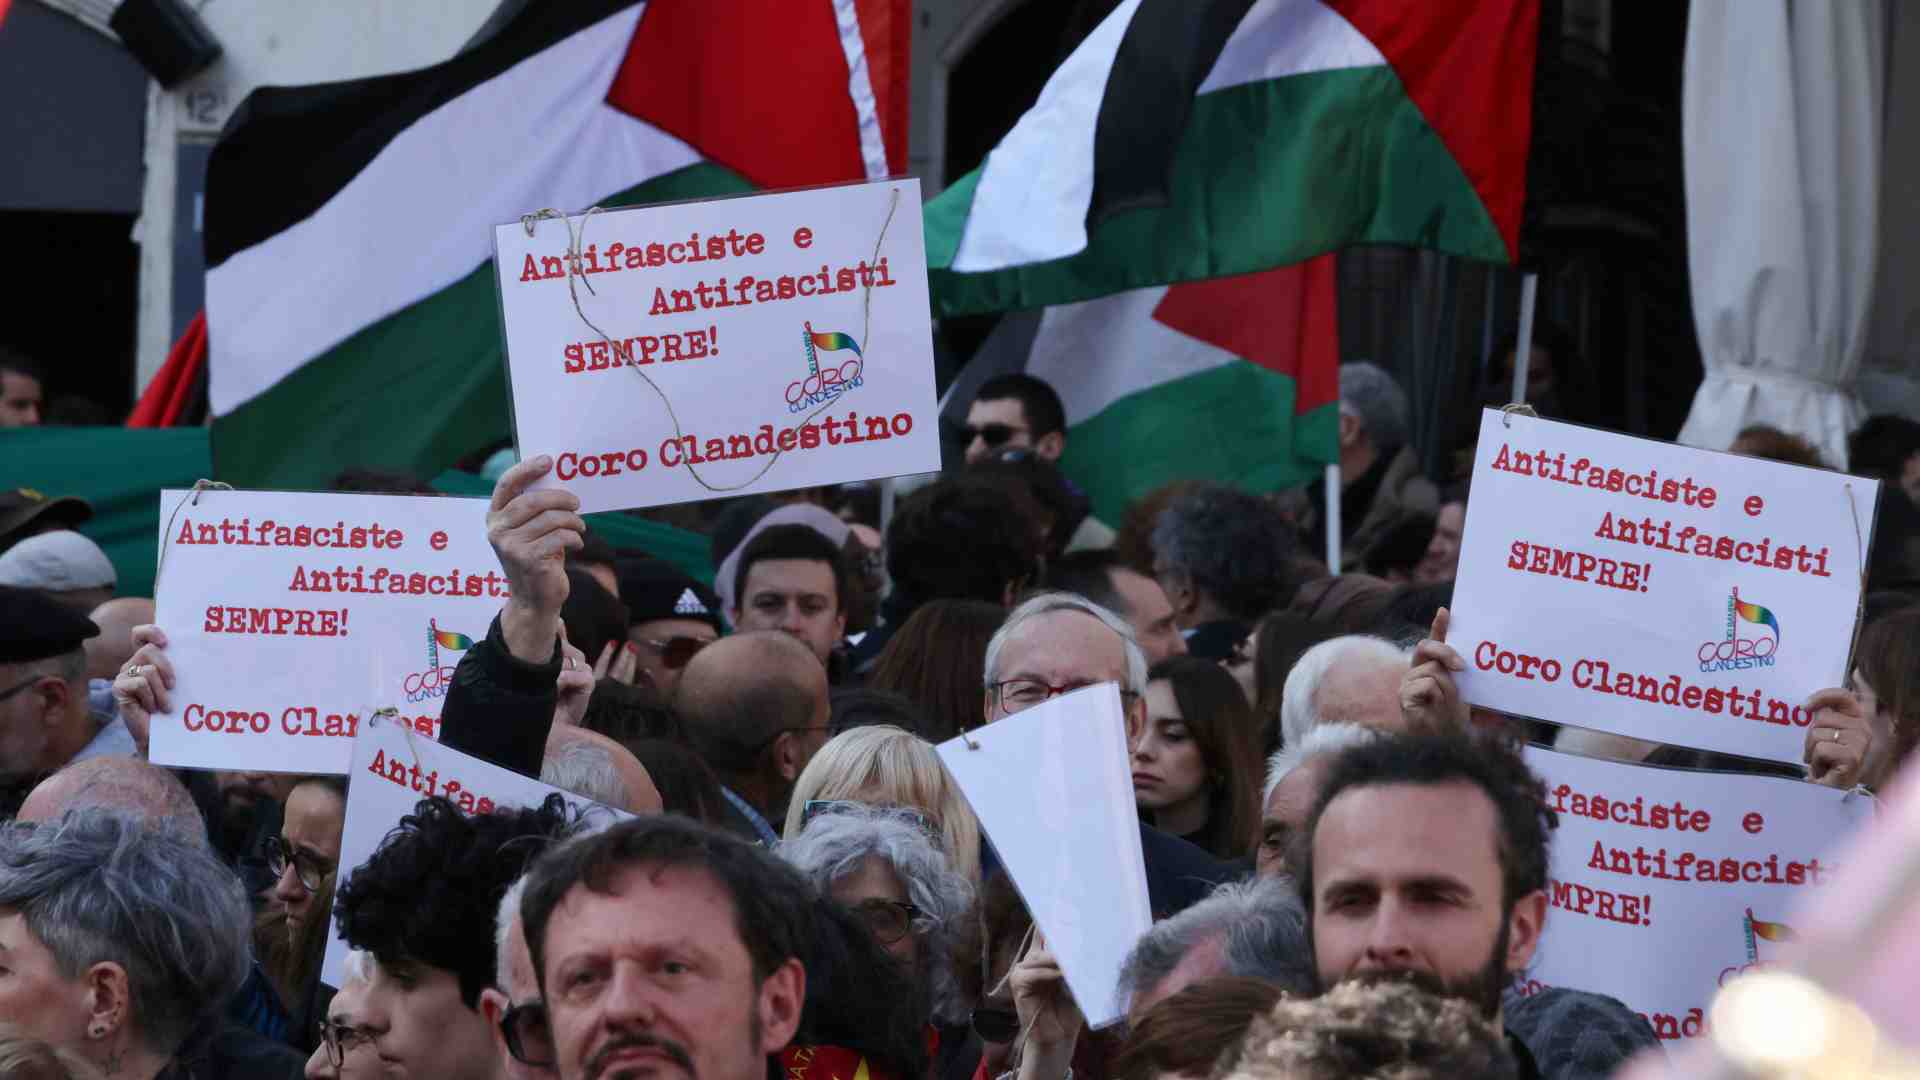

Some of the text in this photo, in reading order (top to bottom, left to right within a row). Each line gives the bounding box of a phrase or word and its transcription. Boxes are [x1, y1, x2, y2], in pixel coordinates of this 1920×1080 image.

[520, 227, 813, 283] Antifasciste e
[648, 258, 897, 317] Antifascisti
[564, 326, 719, 374] SEMPRE!
[555, 411, 913, 482] Coro Clandestino
[1492, 443, 1765, 517] Antifasciste e
[176, 518, 449, 551] Antifasciste e
[1594, 512, 1832, 578] Antifascisti
[1507, 540, 1652, 593] SEMPRE!
[203, 606, 349, 638] SEMPRE!
[1475, 639, 1813, 728] Coro Clandestino
[183, 703, 271, 735] Coro
[368, 749, 496, 816] Antifas
[1551, 784, 1764, 834] fasciste e
[1587, 840, 1823, 887] Antifascist
[1552, 880, 1651, 927] MPRE!
